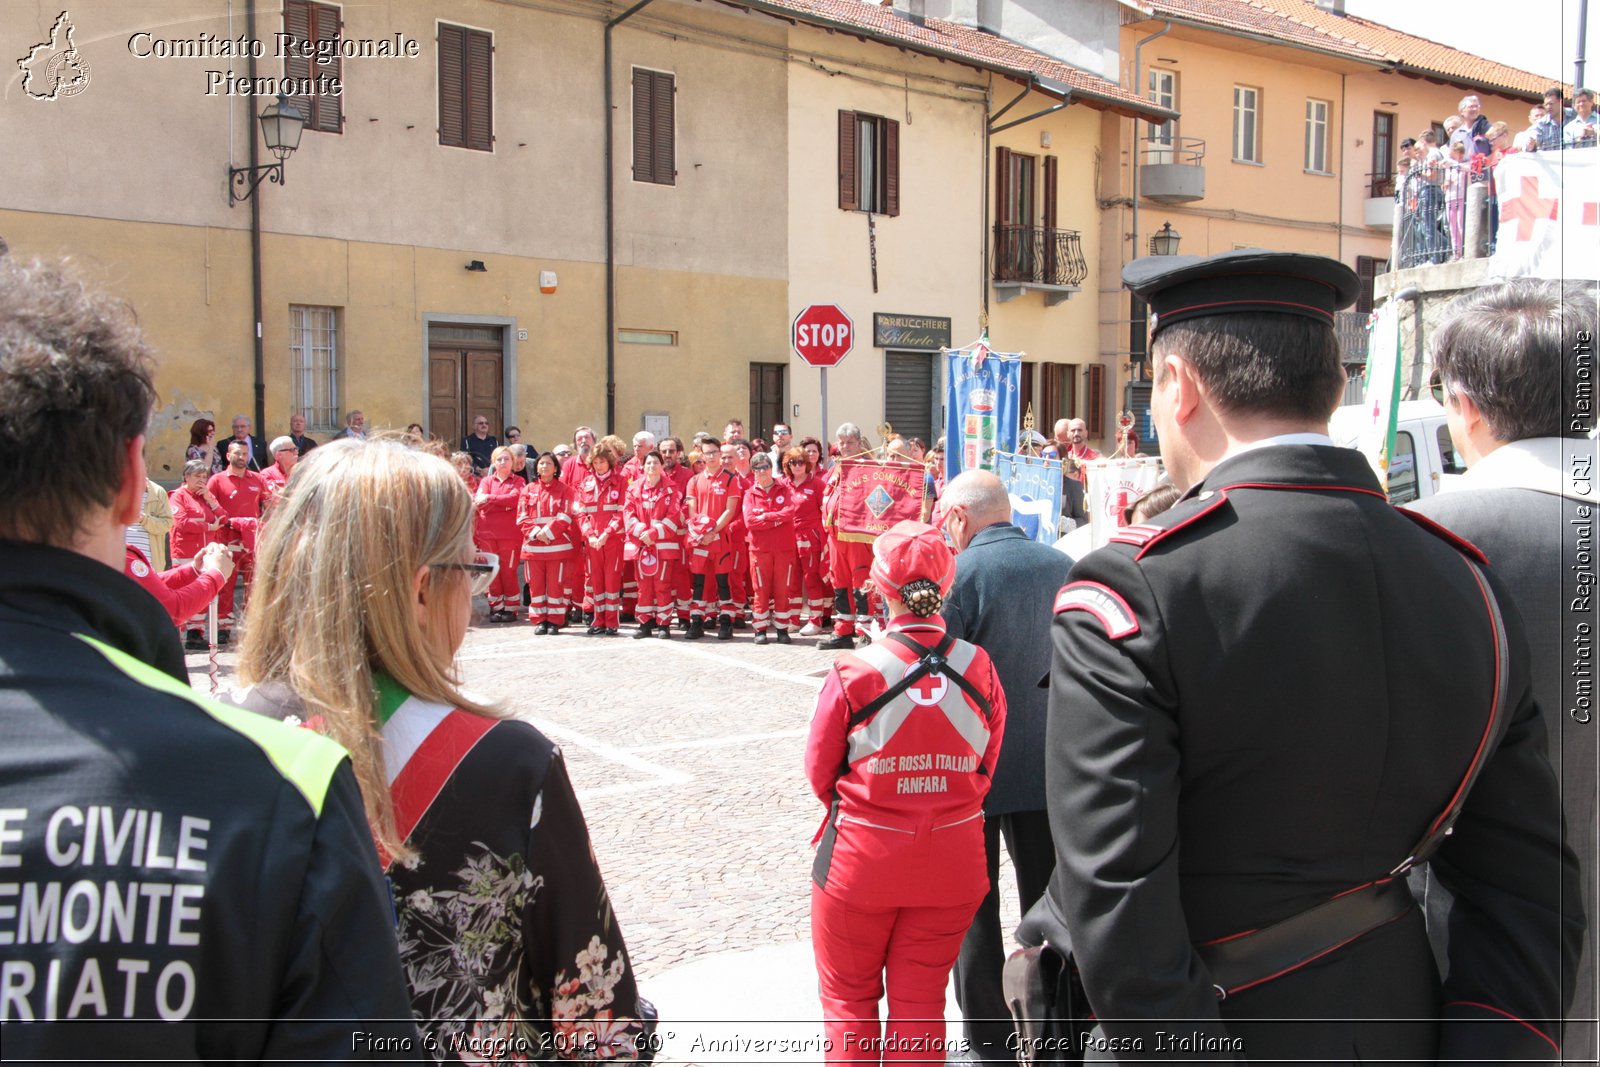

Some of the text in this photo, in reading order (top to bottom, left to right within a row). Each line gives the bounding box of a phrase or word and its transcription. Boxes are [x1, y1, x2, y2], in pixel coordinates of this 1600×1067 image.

[798, 323, 849, 347] STOP
[872, 471, 917, 497] COMUNALE
[867, 756, 897, 774] CROCE
[899, 753, 932, 771] ROSSA
[897, 775, 948, 794] FANFARA
[46, 805, 211, 872] CIVILE
